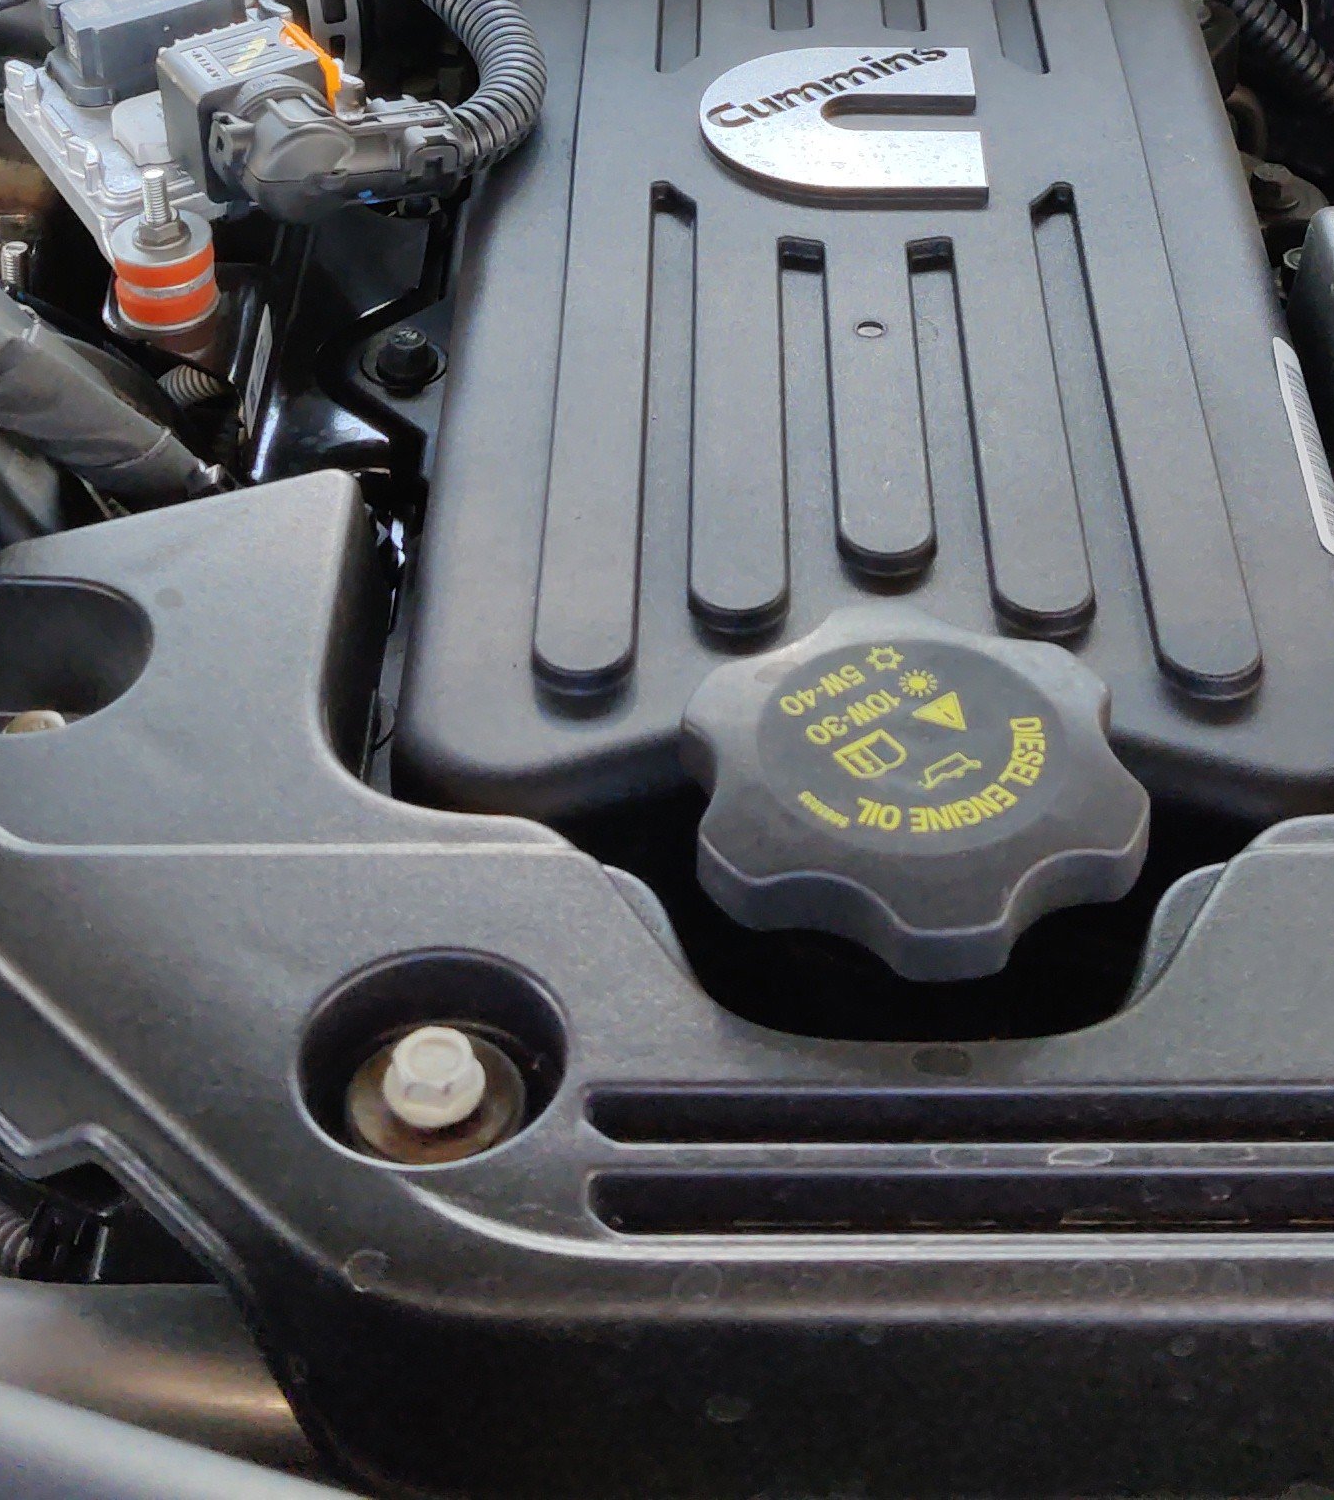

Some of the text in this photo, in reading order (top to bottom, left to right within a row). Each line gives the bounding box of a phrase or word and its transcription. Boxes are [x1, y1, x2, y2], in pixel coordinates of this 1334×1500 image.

[705, 47, 948, 128] Cummins
[999, 716, 1047, 787] DIESEL
[856, 796, 902, 832] OIL
[909, 782, 1019, 833] ENGINE
